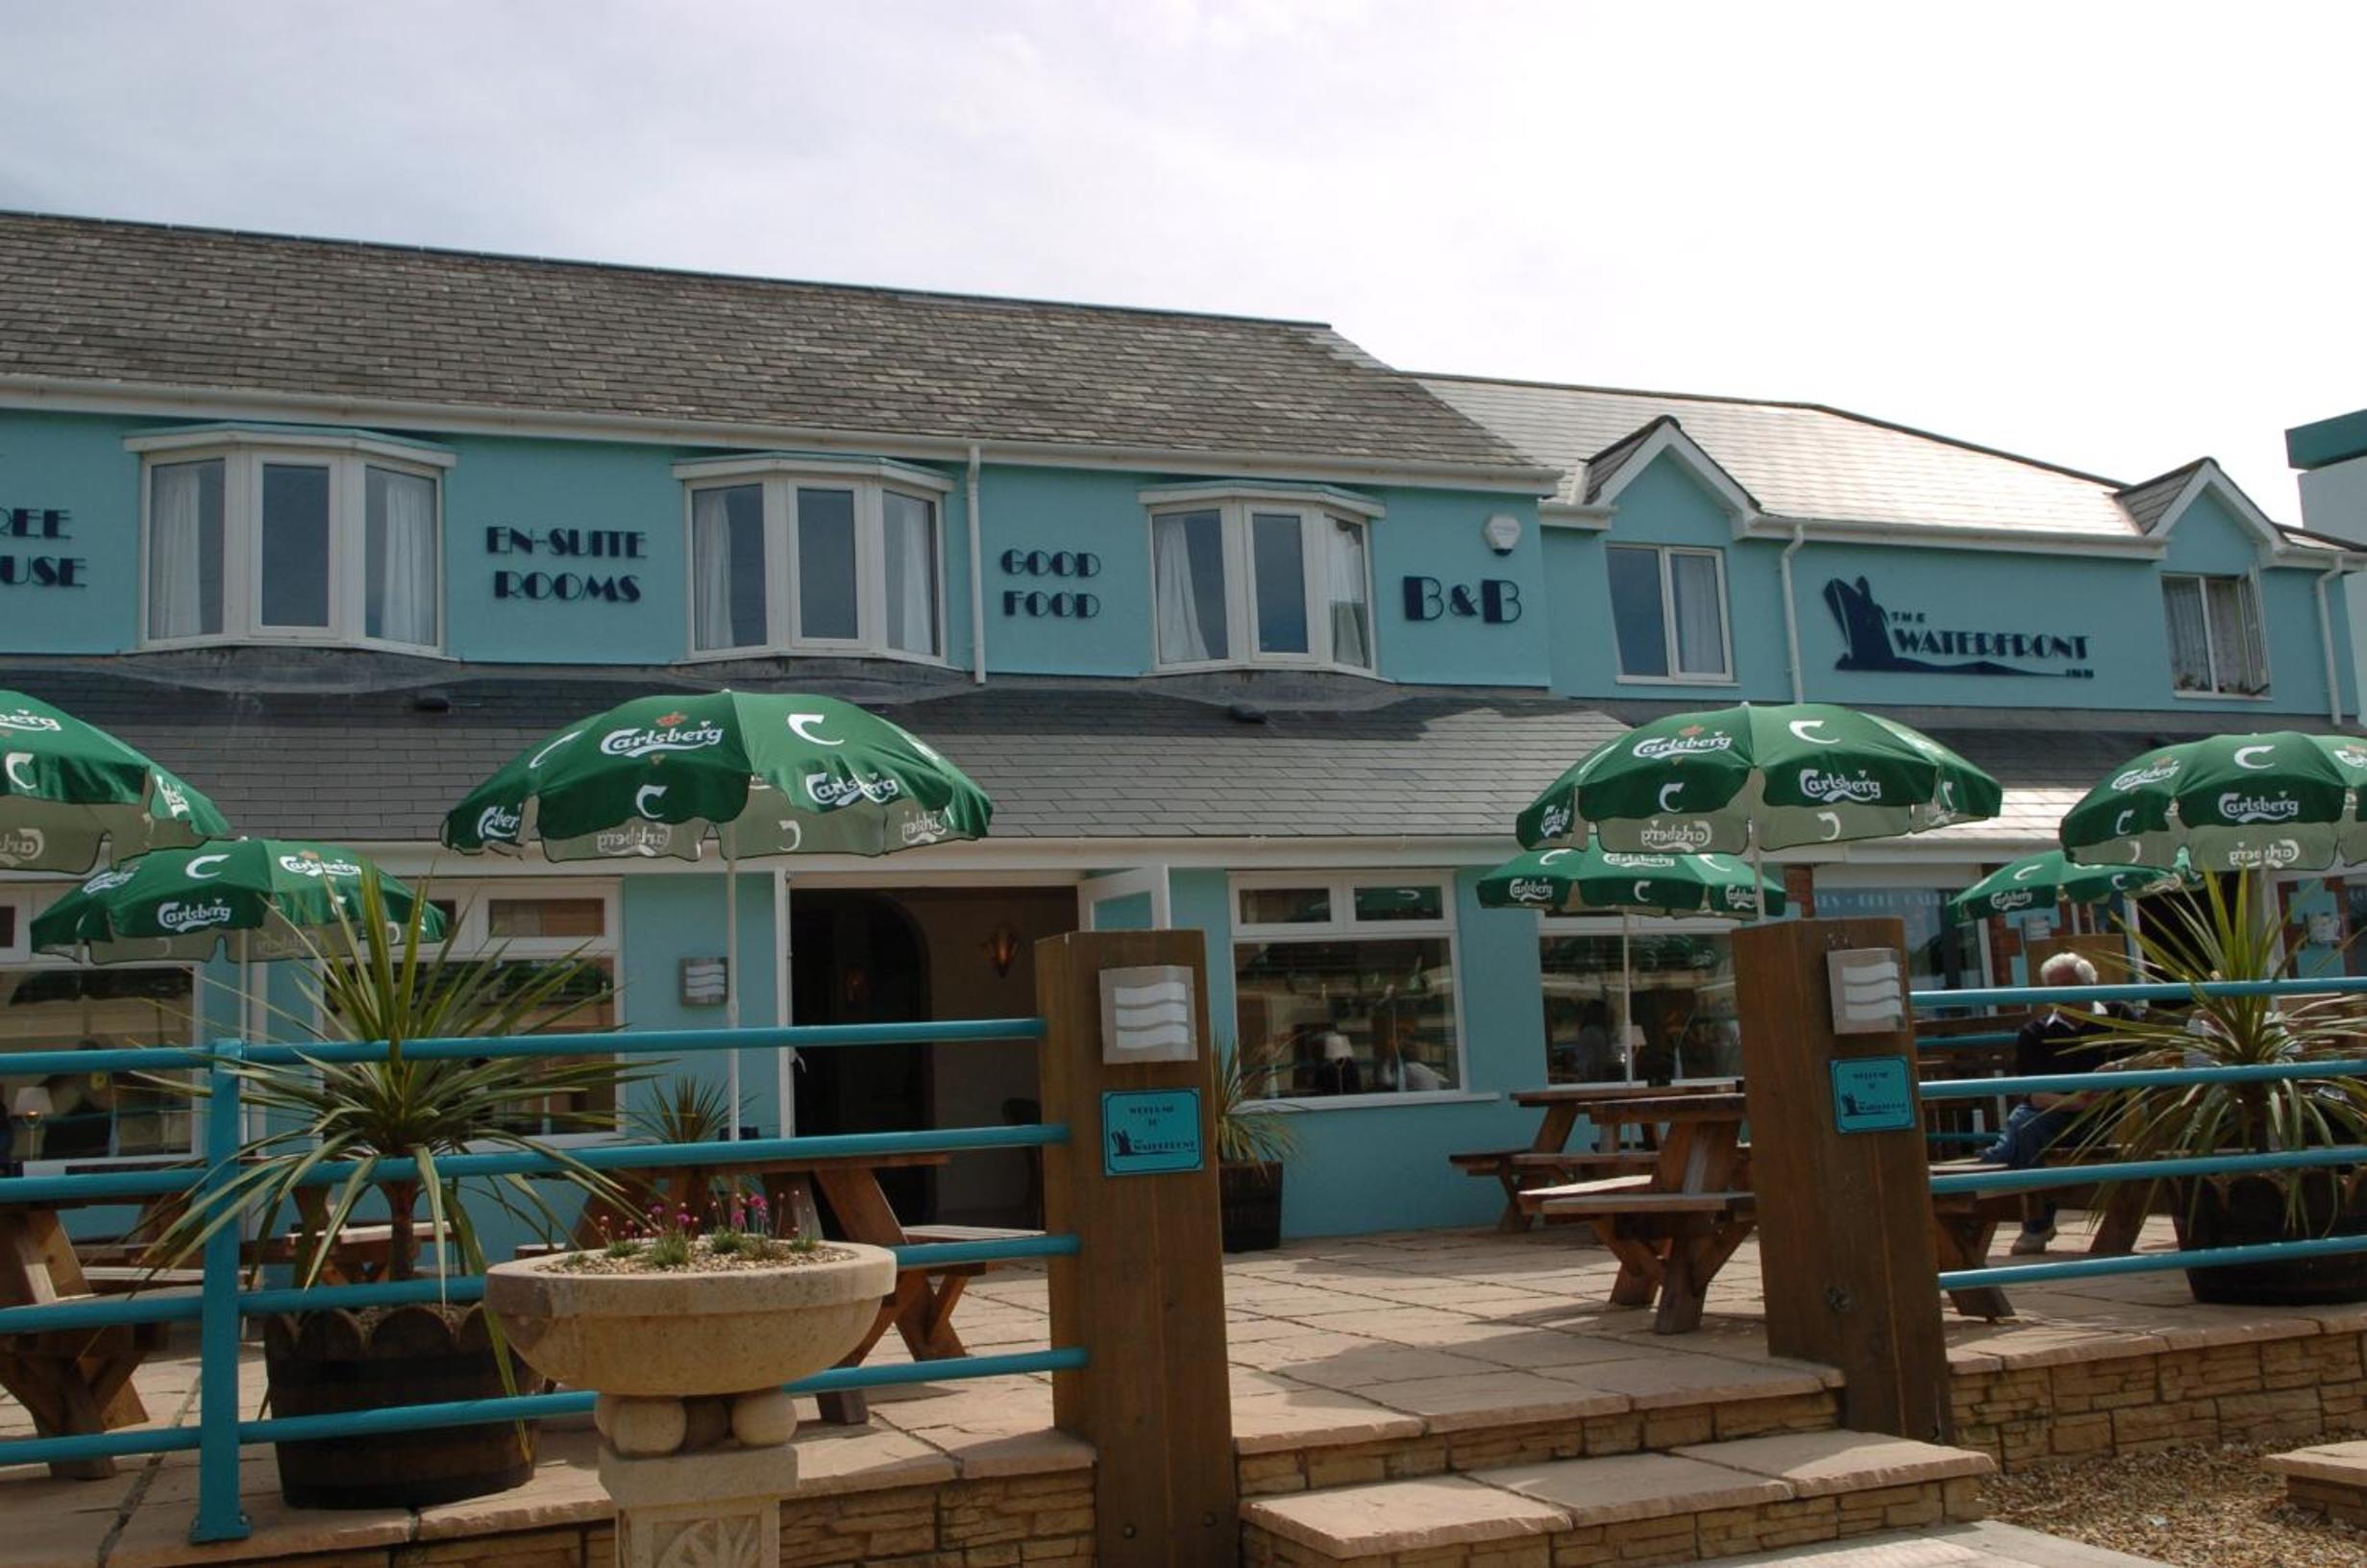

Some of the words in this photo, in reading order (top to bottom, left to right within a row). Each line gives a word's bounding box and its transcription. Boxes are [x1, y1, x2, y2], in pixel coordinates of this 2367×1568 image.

[486, 526, 648, 559] EN-SUITE
[1001, 549, 1101, 578] GOOD
[494, 570, 641, 602] ROOMS
[1403, 576, 1522, 625] B&B
[1003, 590, 1100, 619] FOOD
[1891, 611, 1925, 623] THE
[1893, 628, 2089, 660] WATERFRONT
[2065, 668, 2094, 678] INN
[600, 721, 724, 758] Carlsberg
[1633, 731, 1733, 759] Carlsberg
[1799, 769, 1883, 803] Carlsberg
[2218, 791, 2299, 823] Carlsberg
[1510, 876, 1554, 901] Carlsberg
[157, 897, 232, 933] Carlsberg
